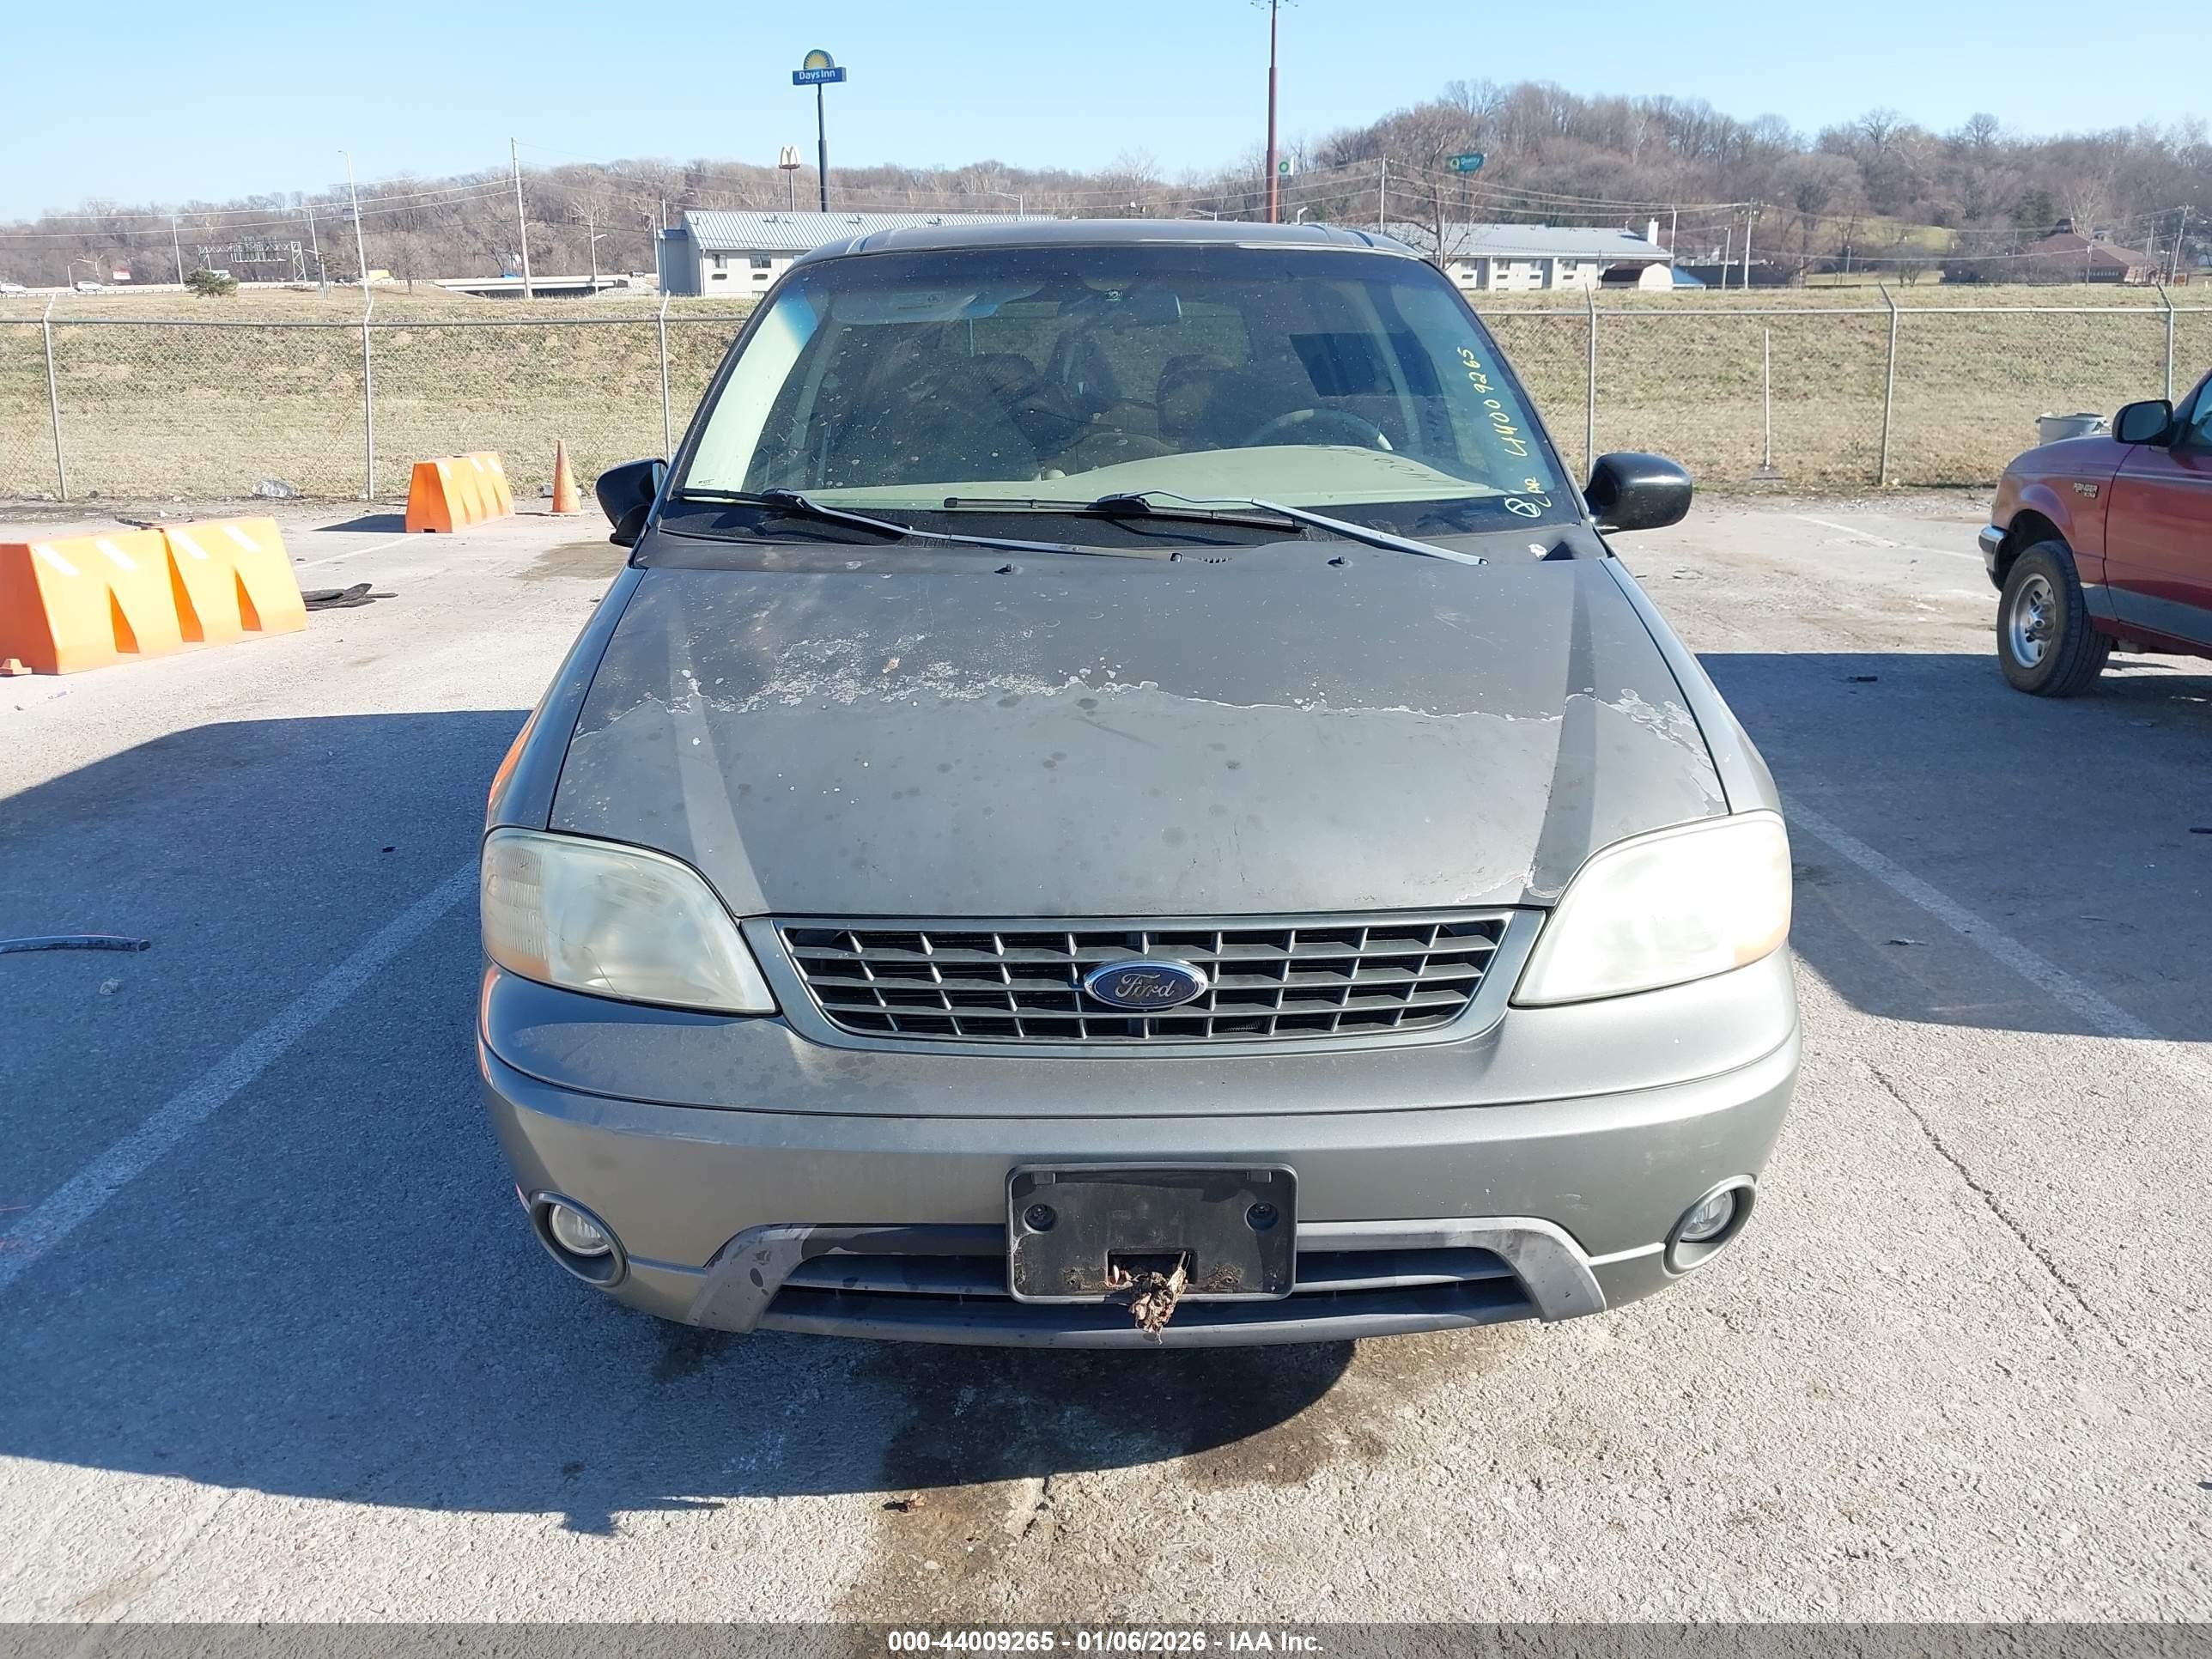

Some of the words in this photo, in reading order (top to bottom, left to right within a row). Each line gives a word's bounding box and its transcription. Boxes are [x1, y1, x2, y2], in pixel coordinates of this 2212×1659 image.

[799, 70, 820, 80] Days
[821, 69, 836, 78] Inn
[1115, 973, 1176, 997] Ford
